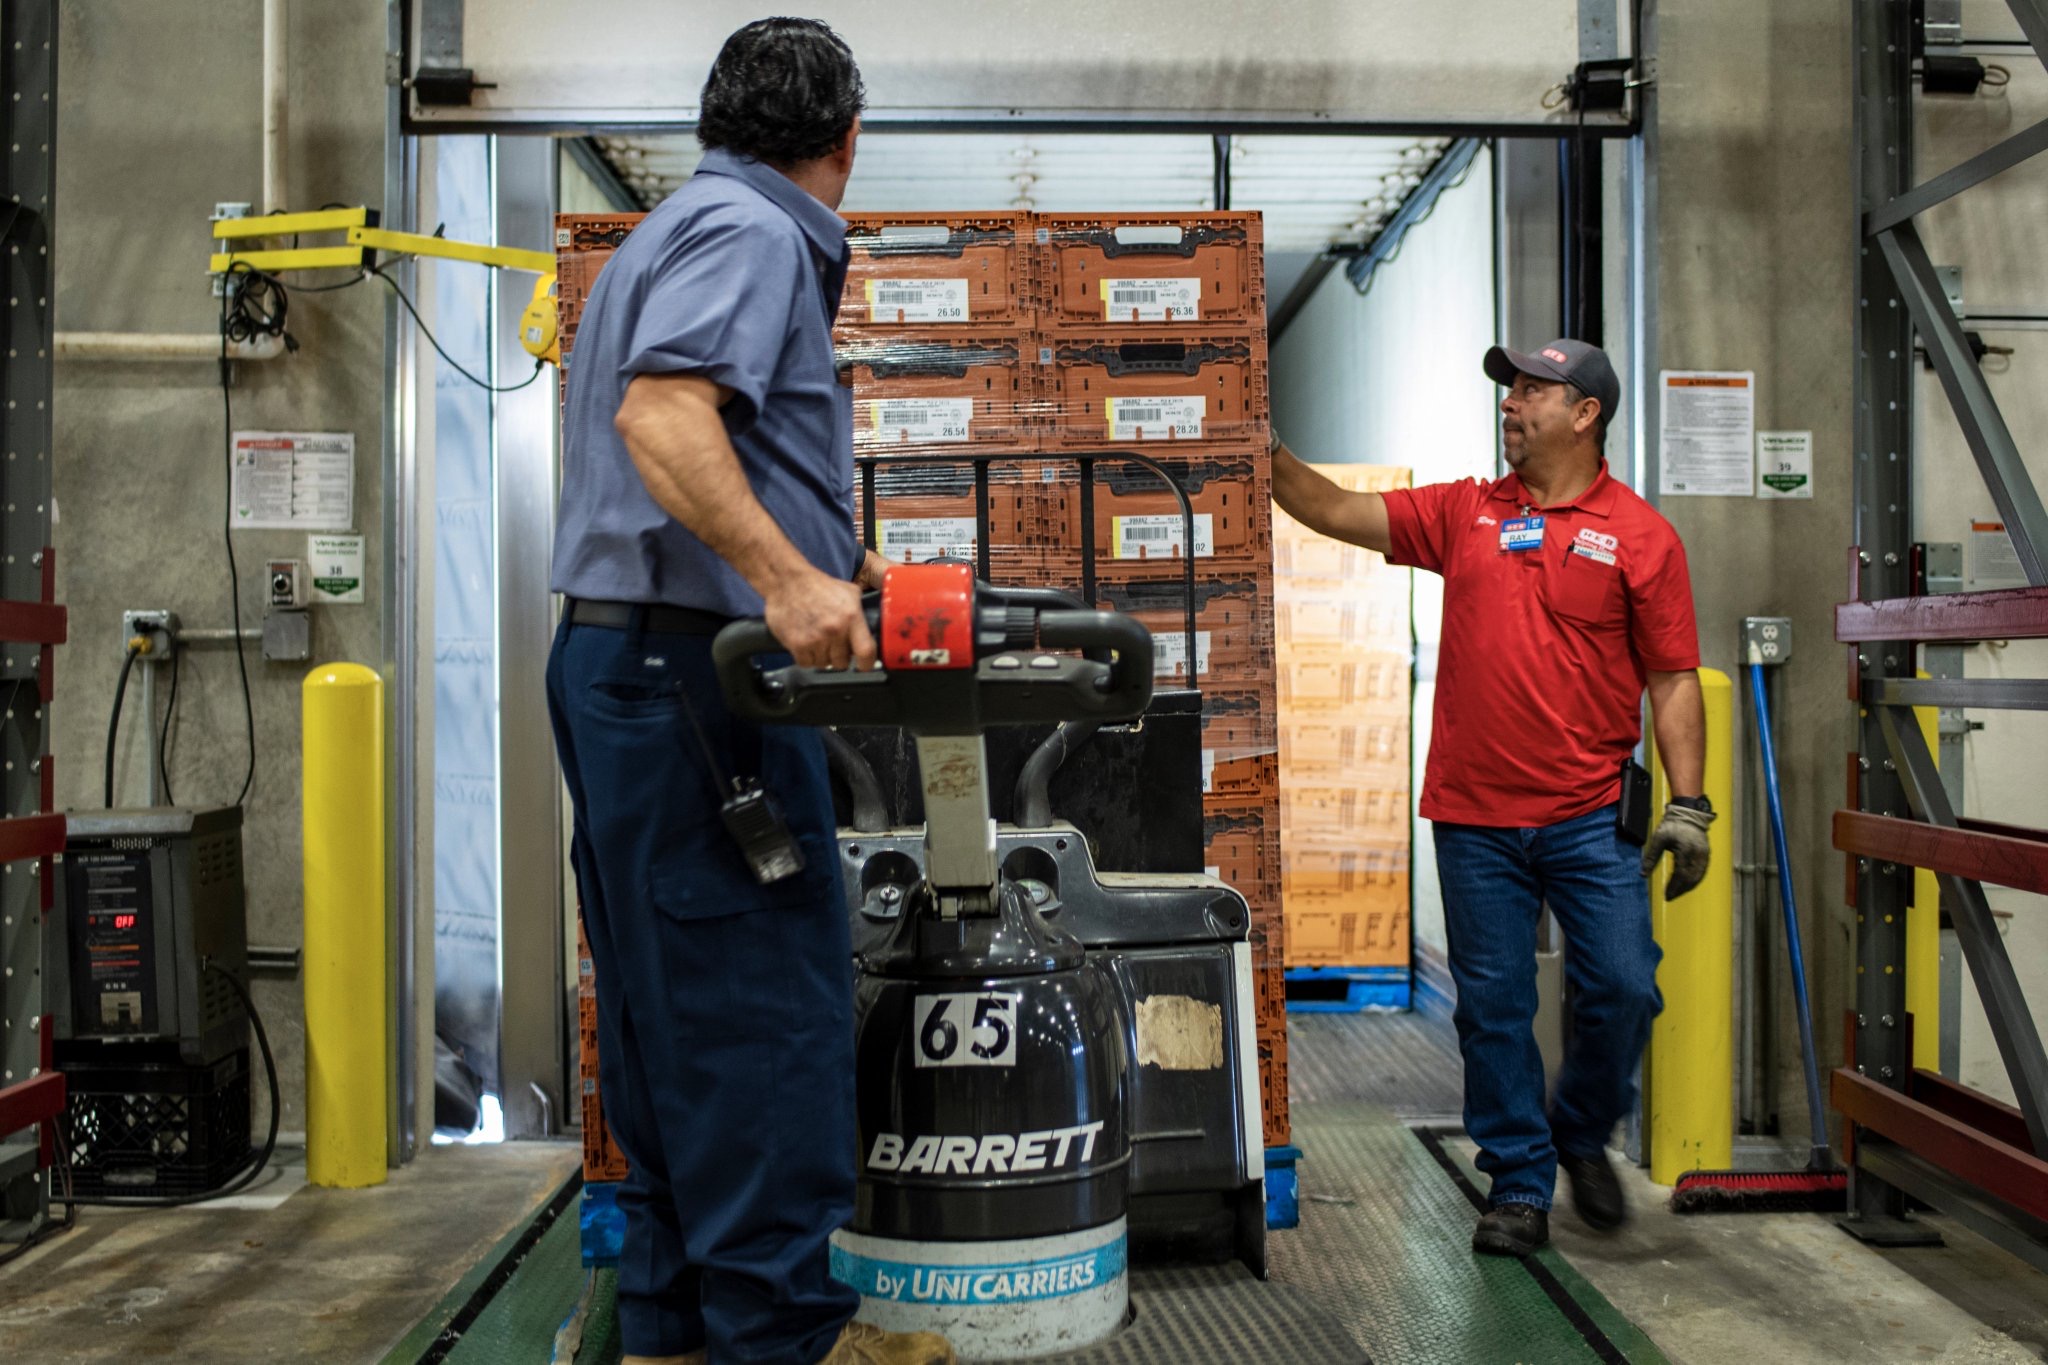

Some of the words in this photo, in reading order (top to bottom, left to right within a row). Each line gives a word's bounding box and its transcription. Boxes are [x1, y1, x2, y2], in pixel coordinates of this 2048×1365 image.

[937, 307, 961, 317] 26.50
[1171, 306, 1194, 316] 26.36
[942, 427, 965, 437] 26.54
[1176, 424, 1199, 434] 28.28
[1509, 533, 1528, 542] RAY
[330, 565, 342, 576] 38
[920, 998, 1010, 1060] 65
[867, 1120, 1104, 1174] BARRETT
[876, 1268, 905, 1300] by
